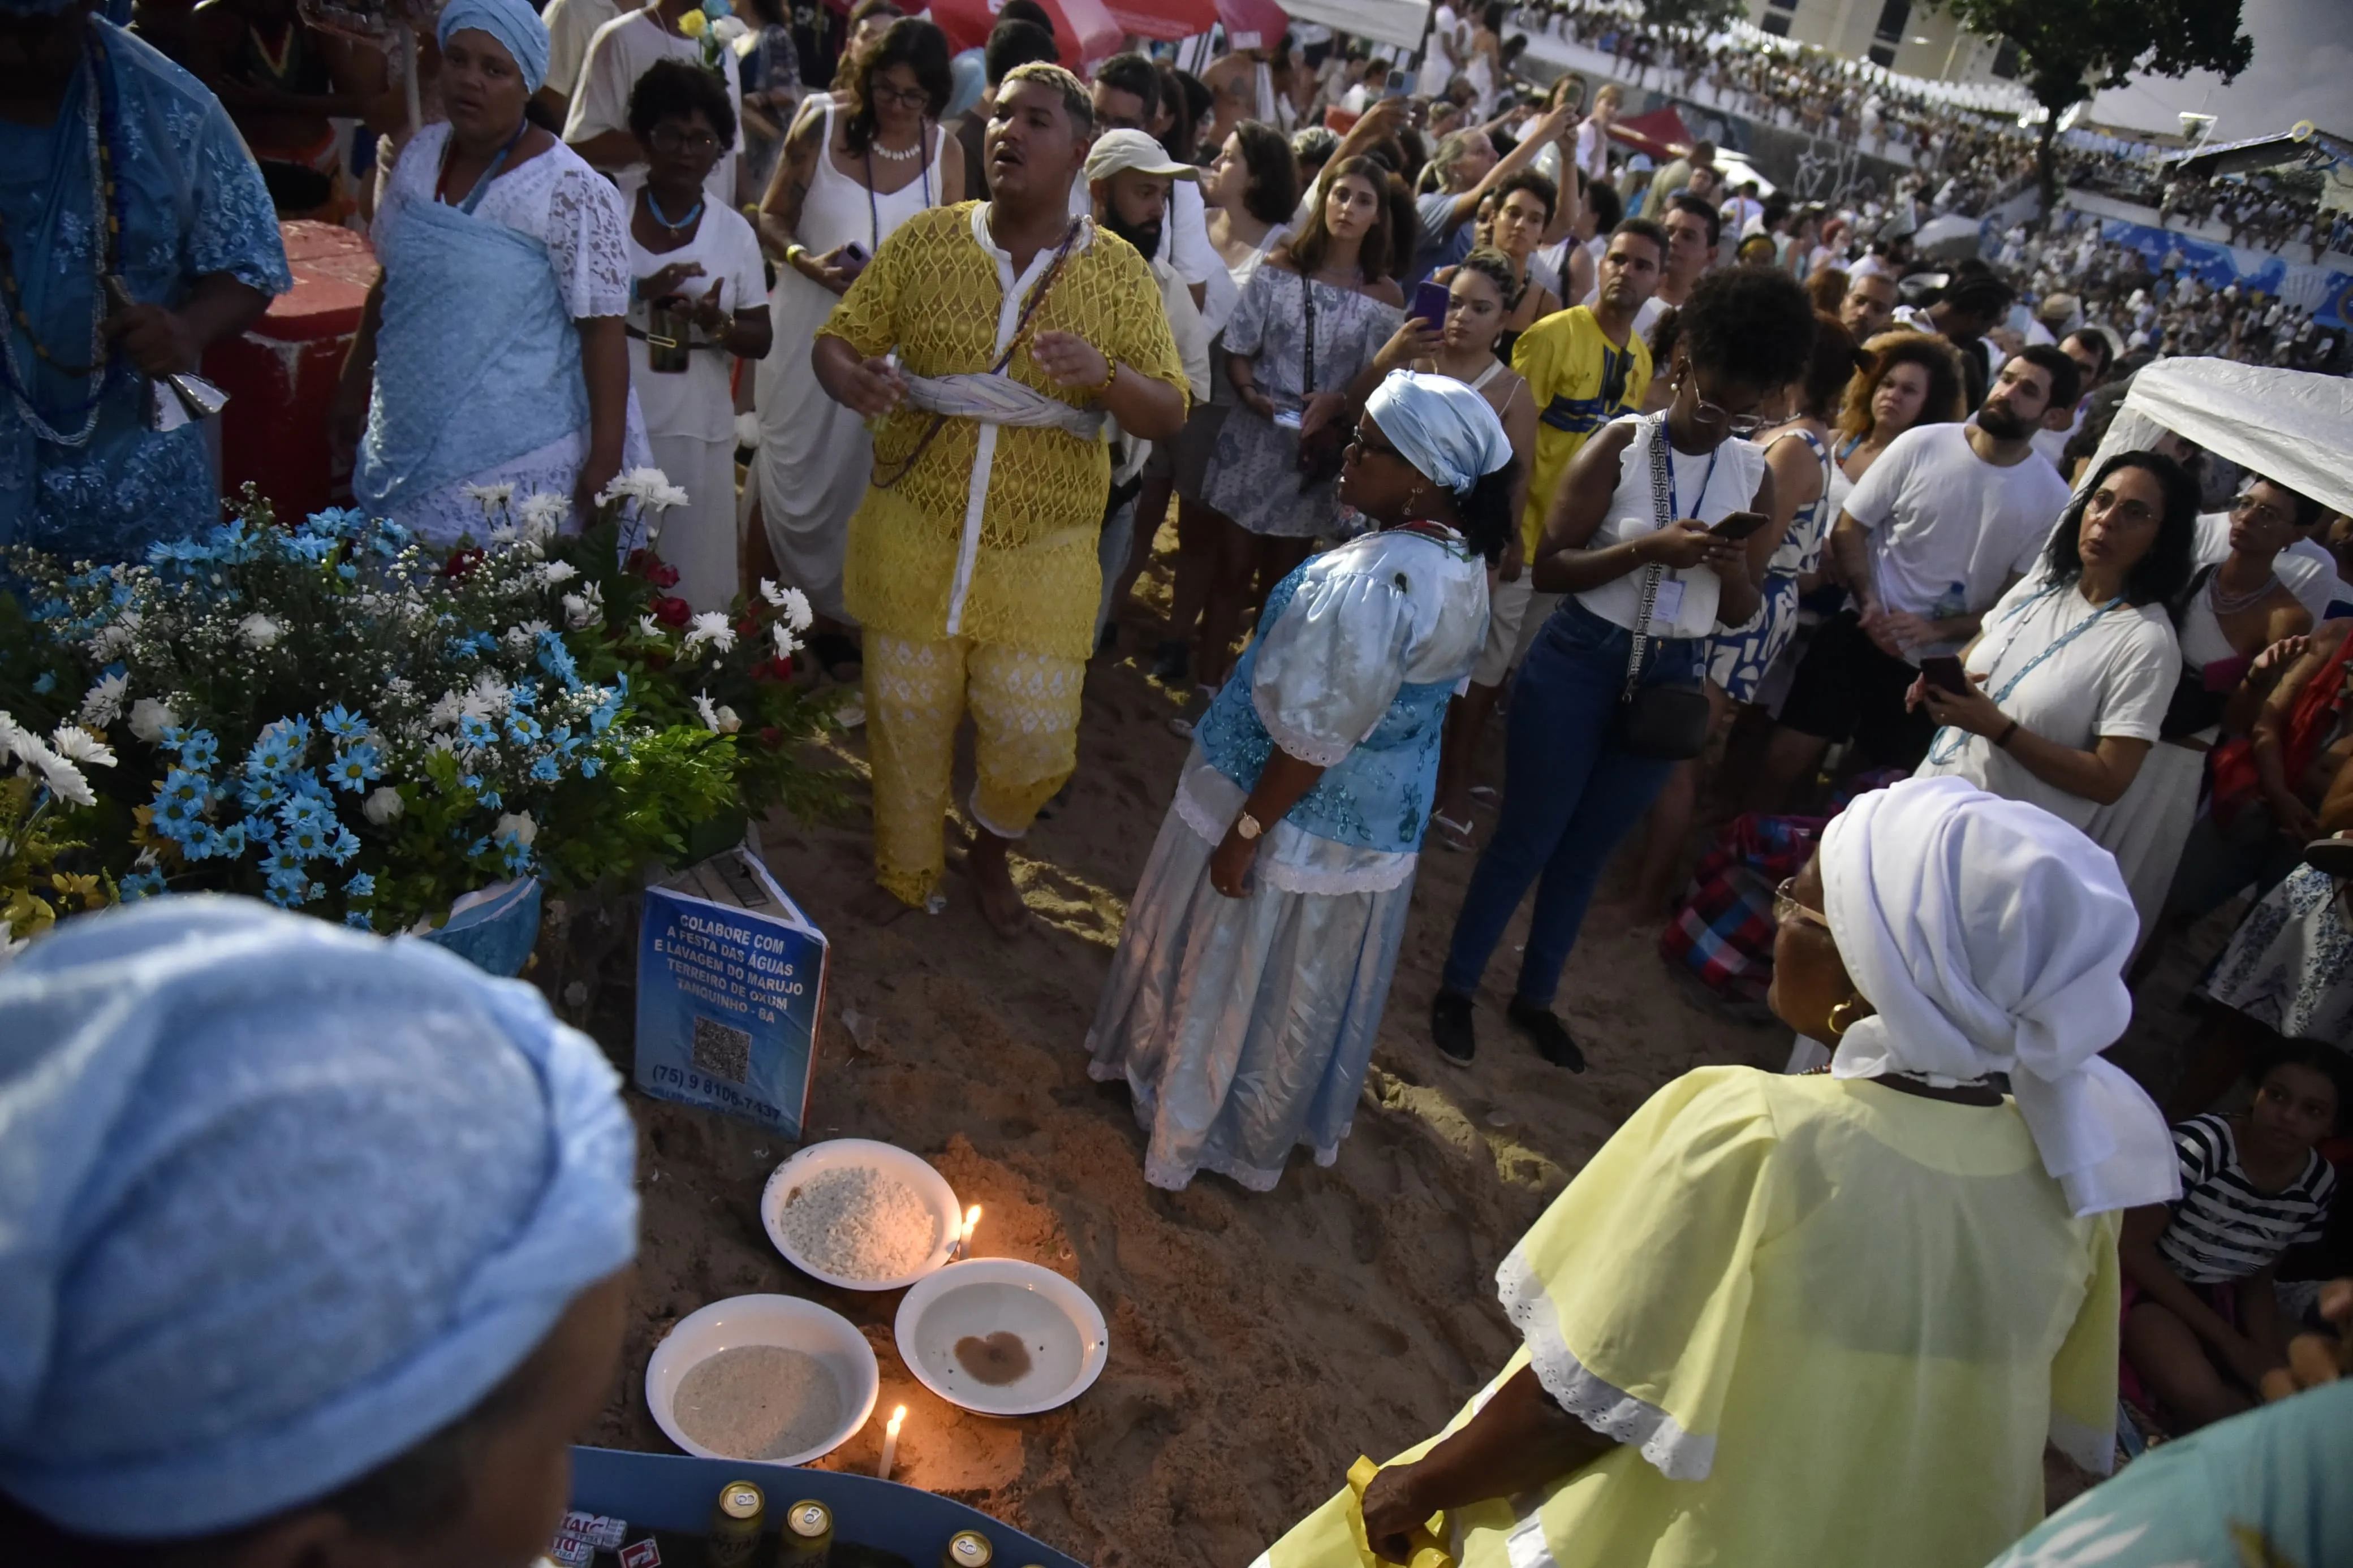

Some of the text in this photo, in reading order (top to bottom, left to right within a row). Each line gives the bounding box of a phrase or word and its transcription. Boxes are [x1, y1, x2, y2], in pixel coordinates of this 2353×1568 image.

[667, 926, 794, 977] A FESTA DAS ÁGUAS
[680, 914, 784, 954] COLABORE COM
[654, 939, 803, 996] E LAVAGEM DO MARUJO
[667, 957, 788, 1010] TERREIRO DE OXUM
[676, 977, 748, 1013] TANQUINHO
[759, 1008, 774, 1023] BA
[653, 1064, 683, 1088] (75)
[689, 1075, 699, 1089] 9
